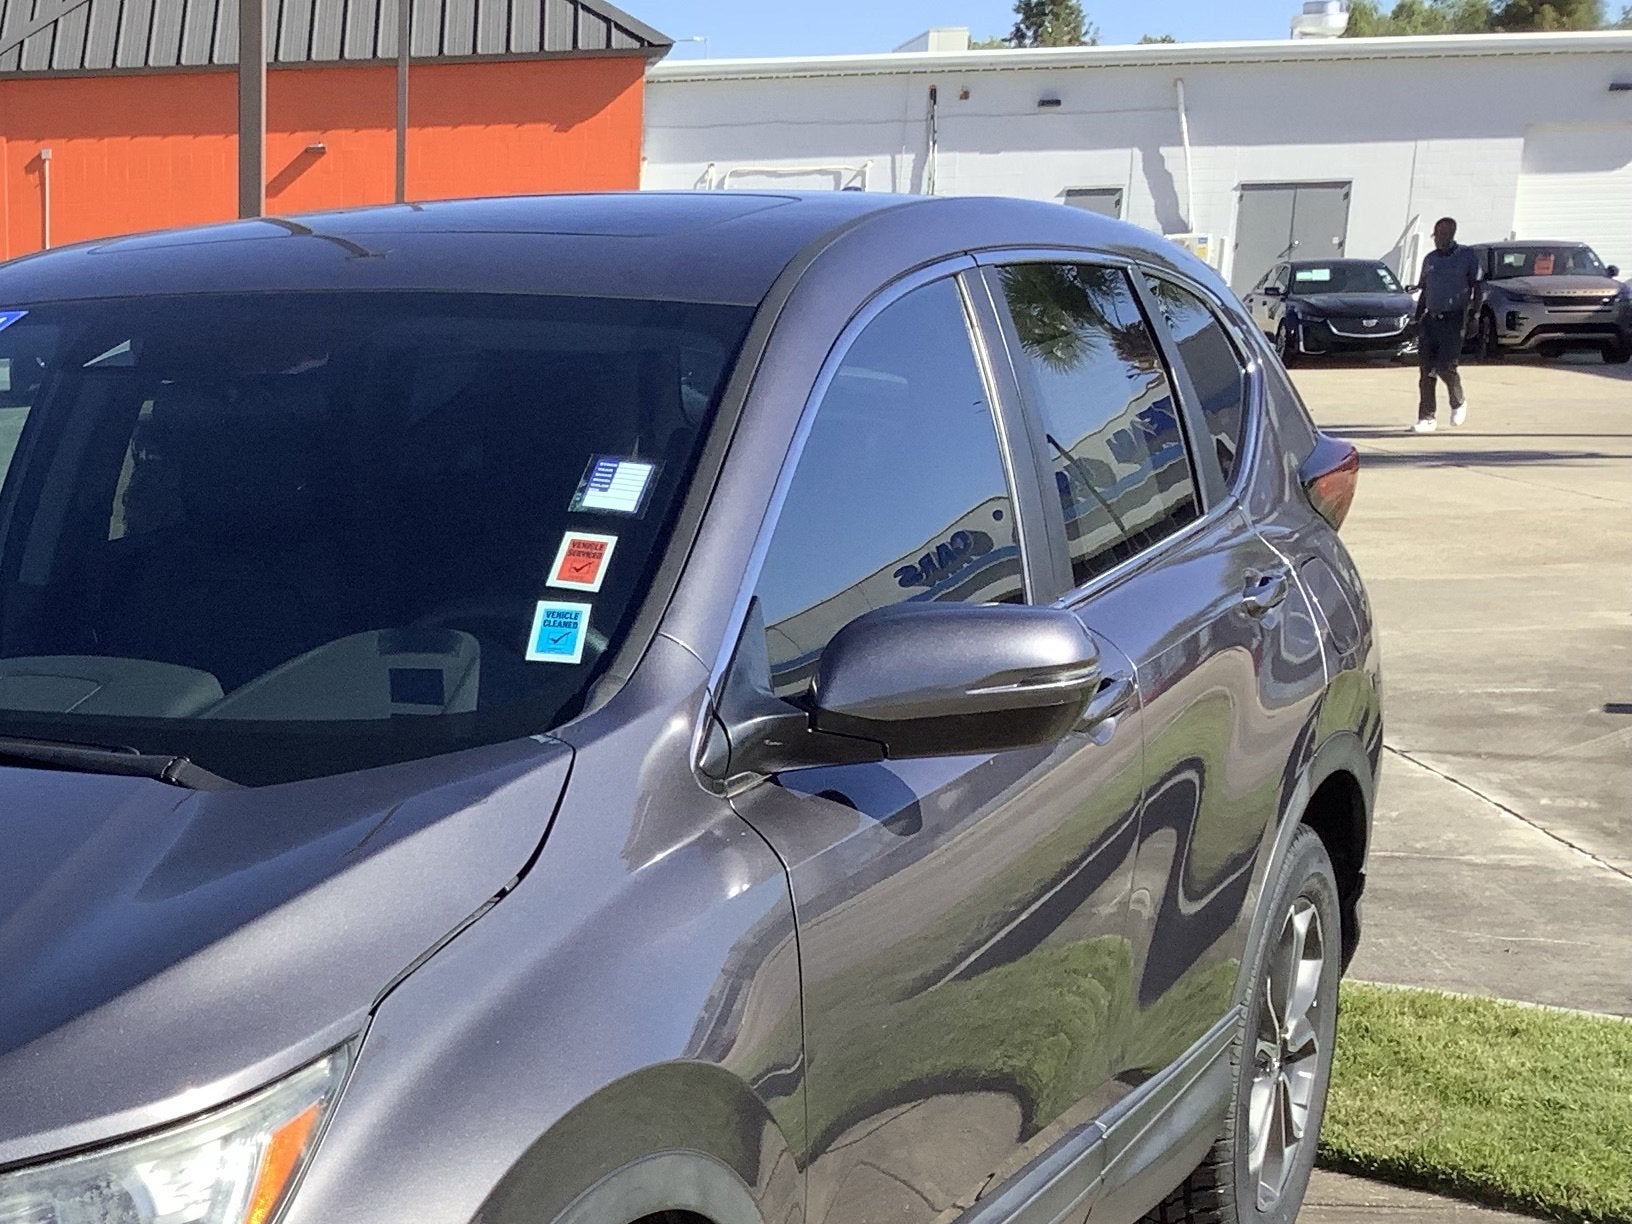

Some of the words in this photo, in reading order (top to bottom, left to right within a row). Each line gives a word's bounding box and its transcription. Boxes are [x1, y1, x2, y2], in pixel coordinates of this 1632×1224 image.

[572, 541, 605, 551] VEHICLE
[546, 611, 580, 621] VEHICLE
[543, 619, 578, 629] CLEANED
